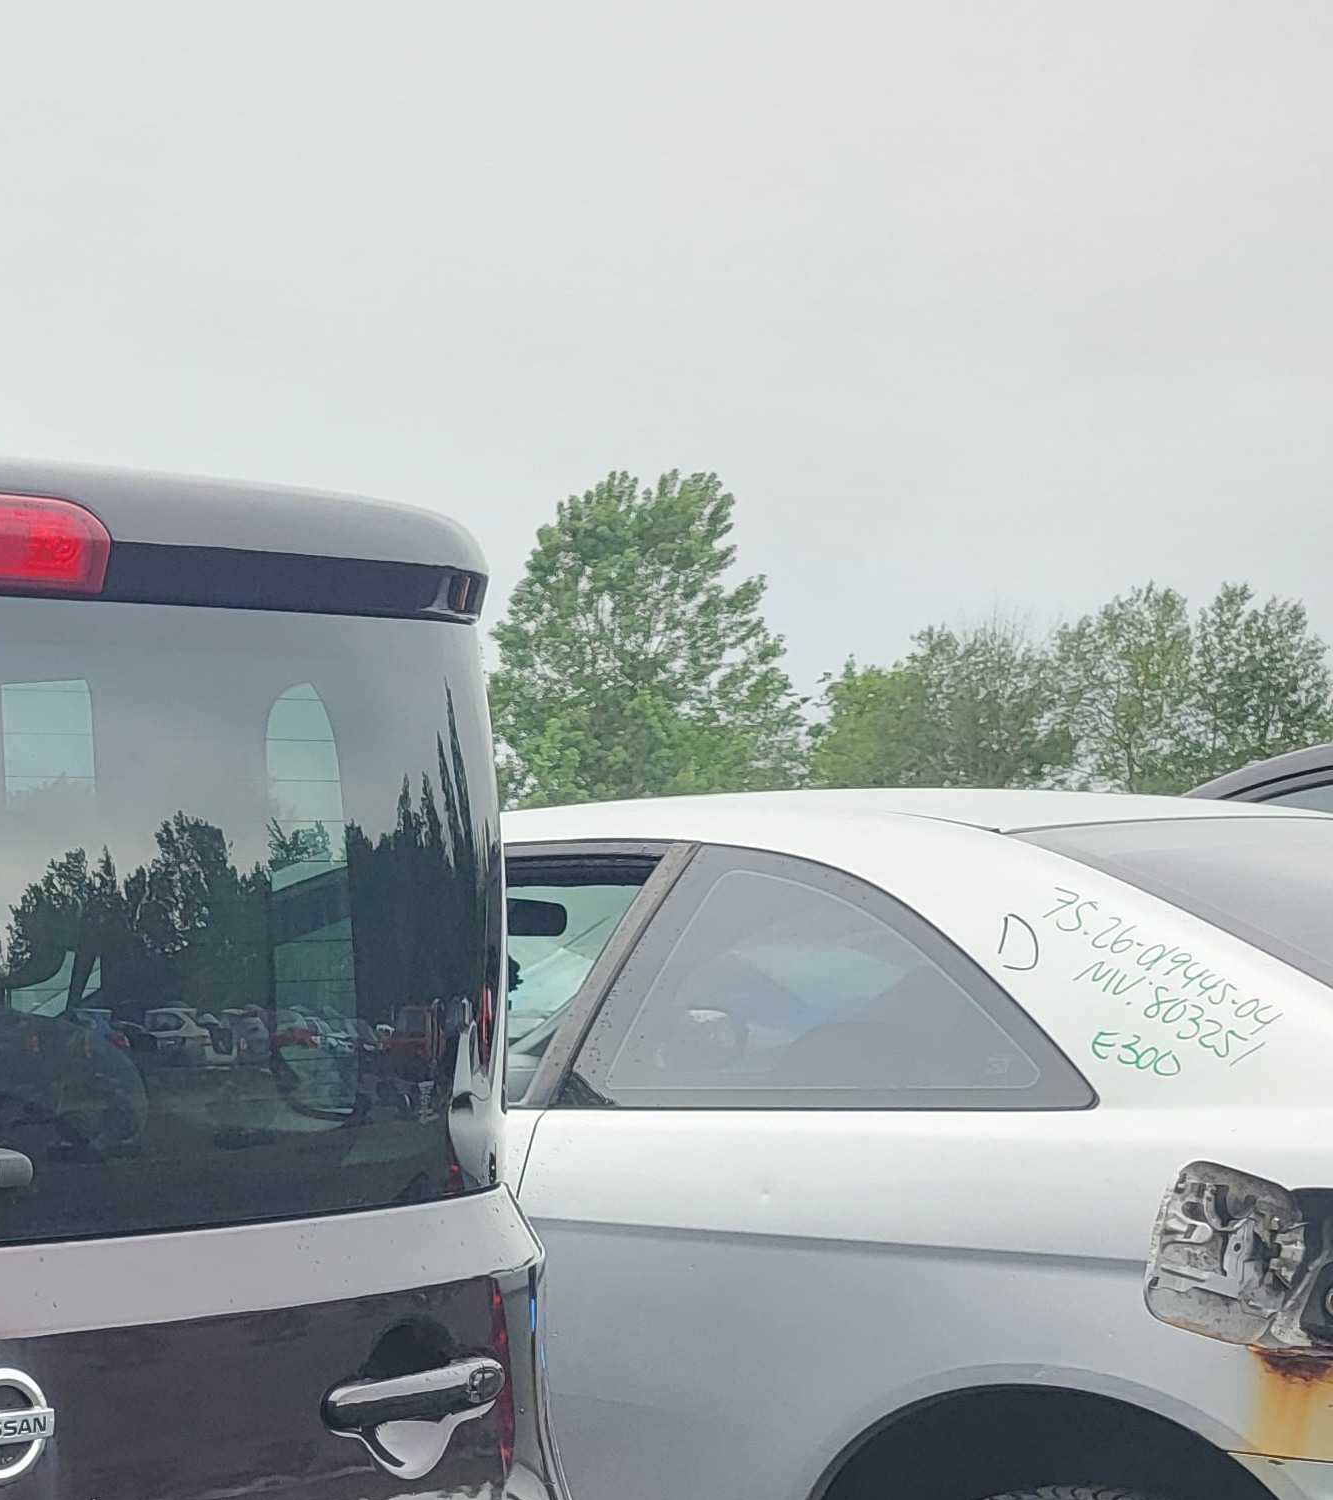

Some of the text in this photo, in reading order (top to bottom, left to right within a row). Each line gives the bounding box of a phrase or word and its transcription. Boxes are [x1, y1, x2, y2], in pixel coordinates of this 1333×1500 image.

[998, 913, 1039, 970] D
[1091, 1031, 1182, 1077] E300
[1143, 986, 1267, 1067] 803251
